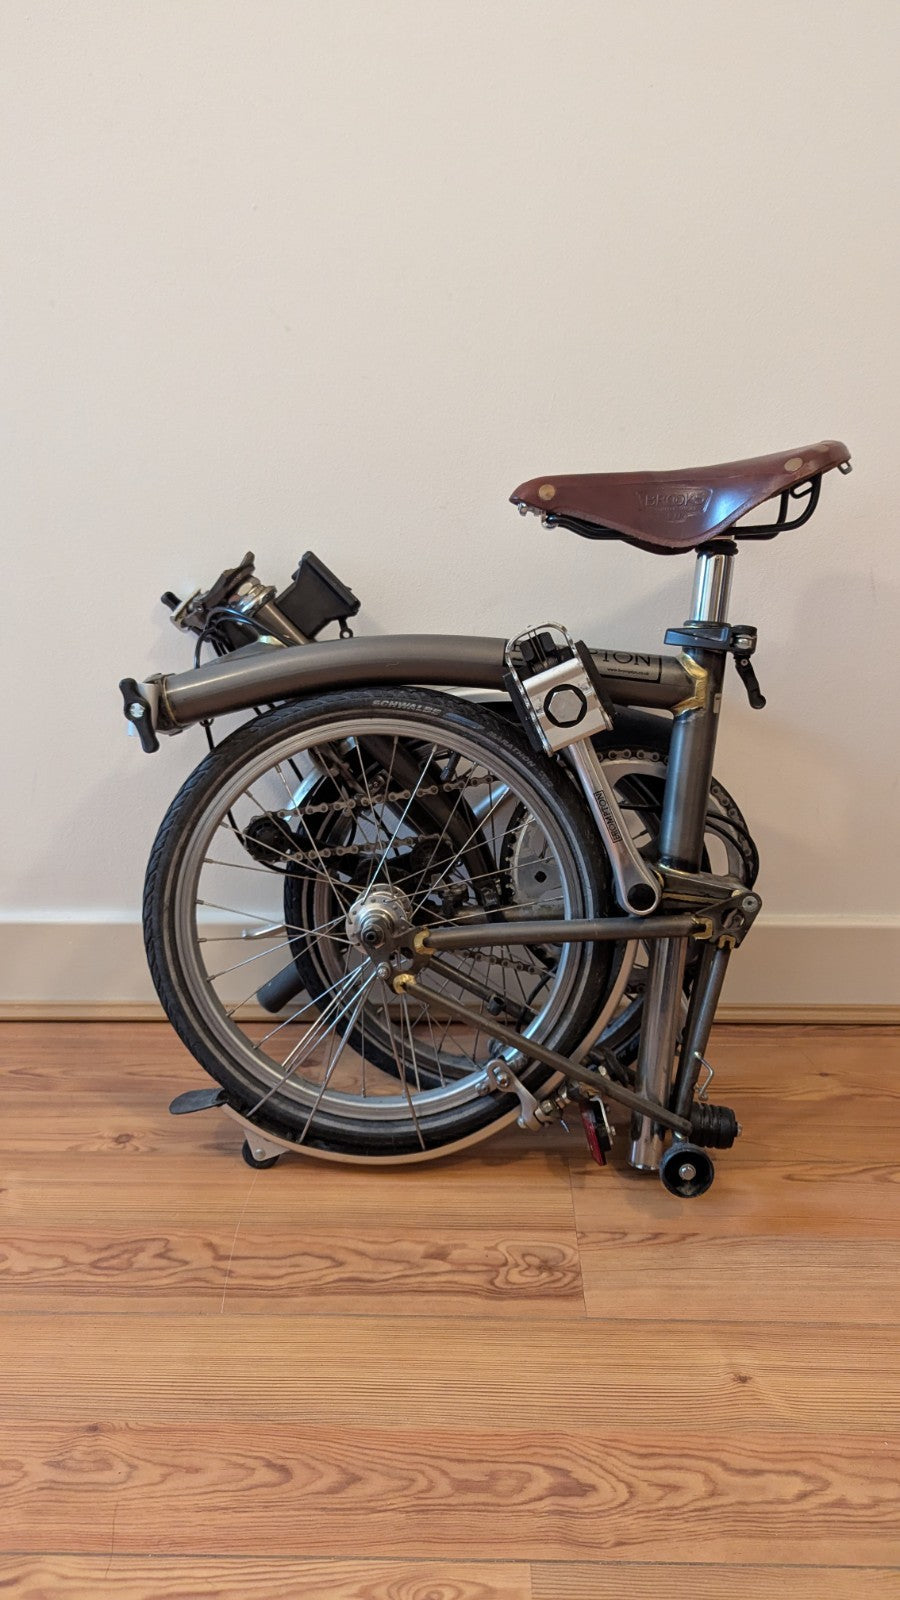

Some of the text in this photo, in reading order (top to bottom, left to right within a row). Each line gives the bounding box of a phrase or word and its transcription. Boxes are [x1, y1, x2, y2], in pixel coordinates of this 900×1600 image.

[645, 490, 706, 506] BROOKS
[372, 700, 442, 716] SCHWALBE
[595, 791, 621, 840] BROMPTON
